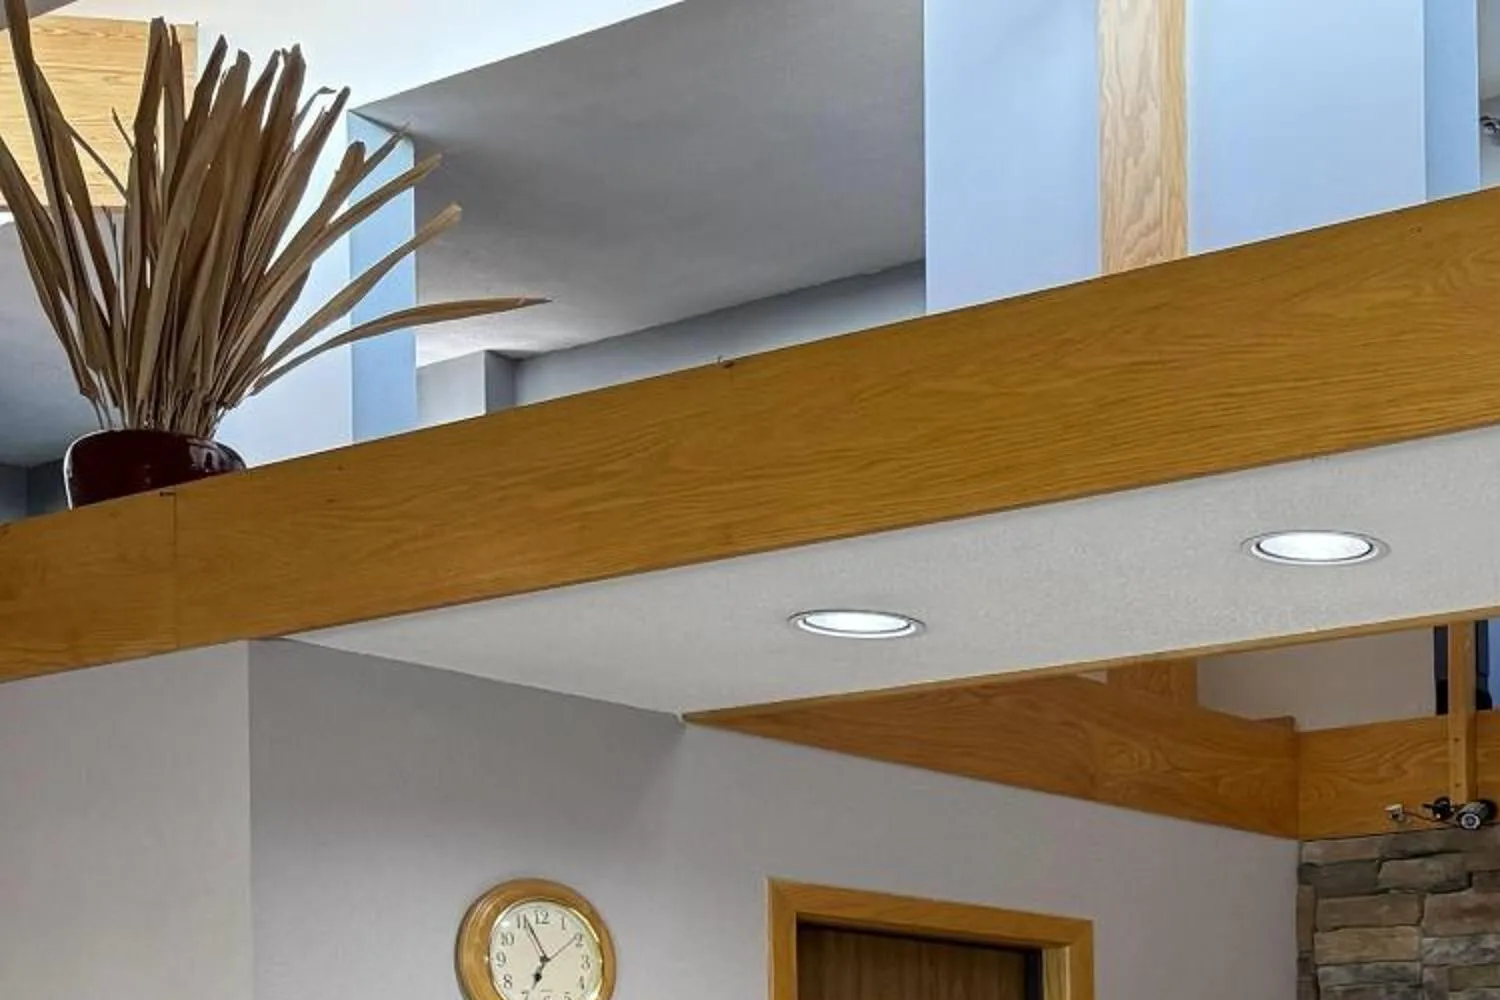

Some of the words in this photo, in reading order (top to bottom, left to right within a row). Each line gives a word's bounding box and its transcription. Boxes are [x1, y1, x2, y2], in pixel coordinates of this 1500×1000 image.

[534, 909, 550, 925] 12
[560, 915, 567, 930] 1
[500, 931, 515, 946] 10
[575, 931, 584, 948] 2
[496, 951, 506, 968] 9
[580, 954, 591, 971] 3
[503, 974, 513, 989] 8
